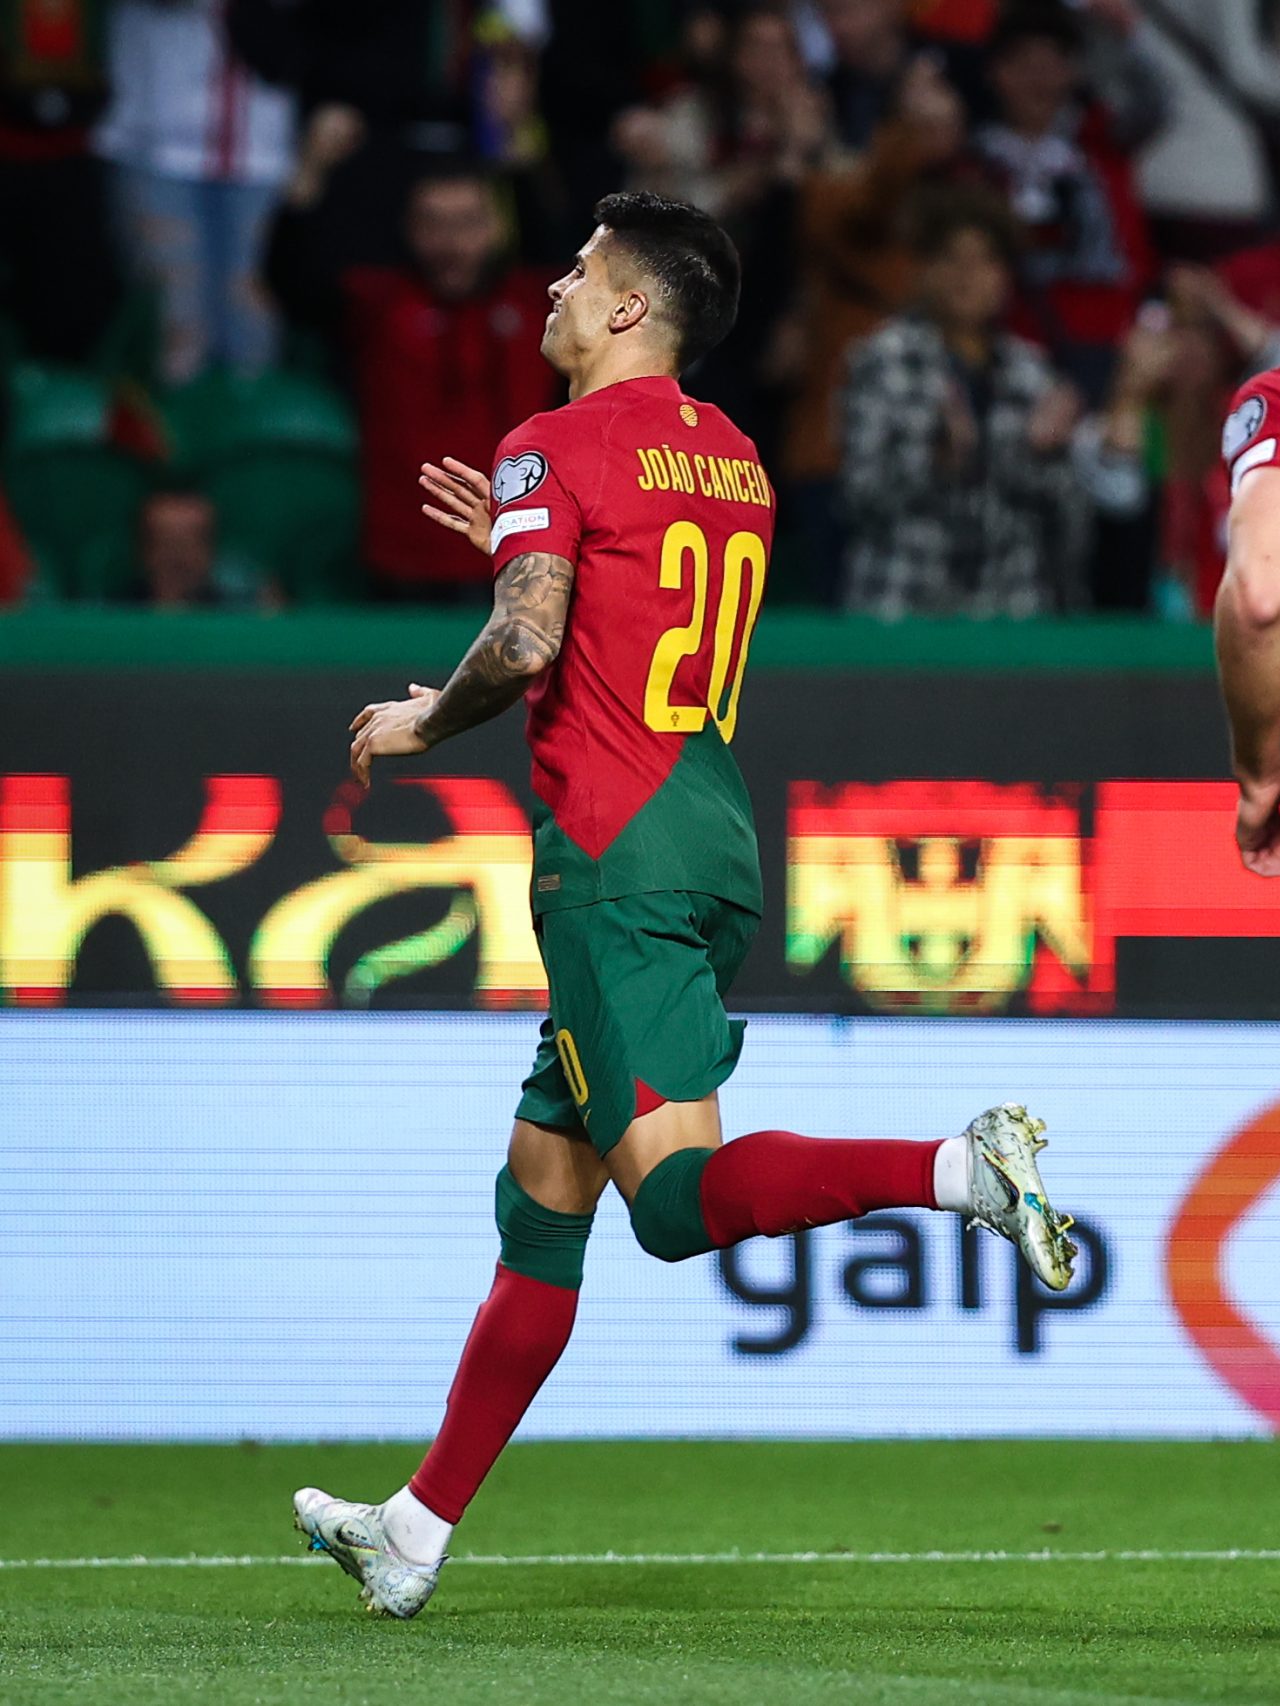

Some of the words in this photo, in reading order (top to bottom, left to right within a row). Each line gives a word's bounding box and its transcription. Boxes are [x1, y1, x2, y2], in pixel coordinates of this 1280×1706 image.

[636, 443, 695, 495] JOÃO
[643, 520, 766, 745] 20
[718, 1212, 1110, 1354] galp
